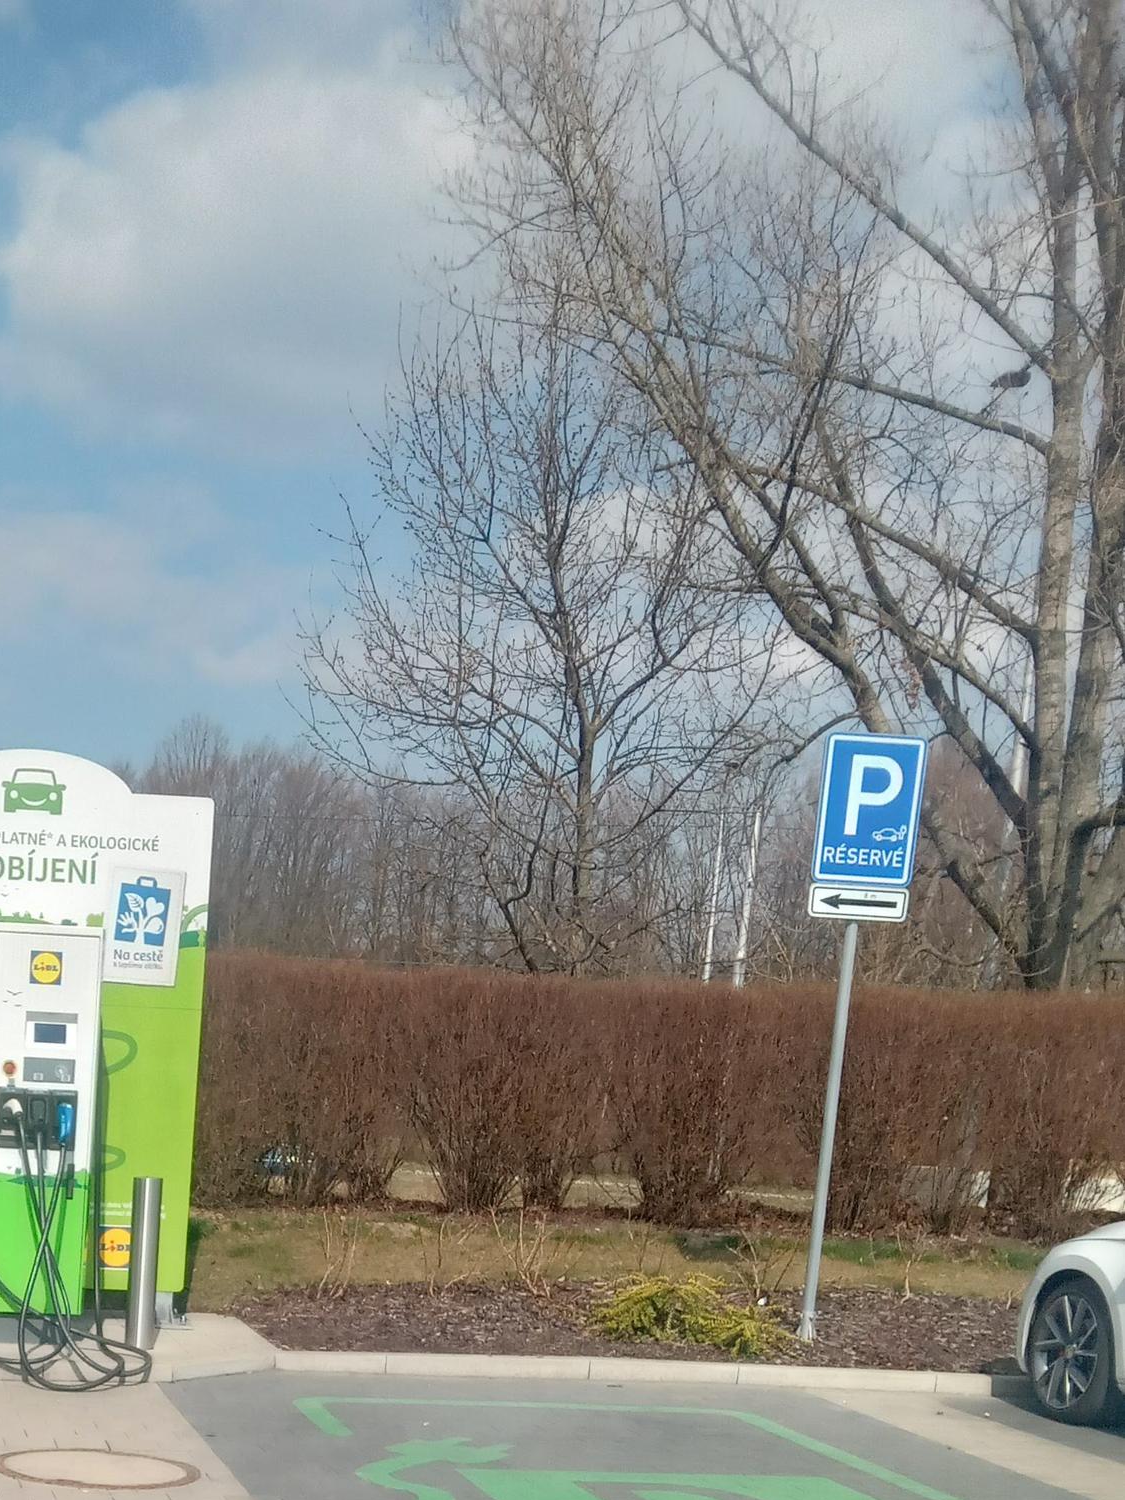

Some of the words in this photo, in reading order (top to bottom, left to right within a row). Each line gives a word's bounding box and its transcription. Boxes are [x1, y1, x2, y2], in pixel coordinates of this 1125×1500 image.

[844, 754, 904, 836] P
[56, 834, 67, 848] A
[70, 835, 160, 852] EKOLOGICKÉ
[822, 843, 904, 868] RÉSERVÉ
[113, 949, 131, 961] Na
